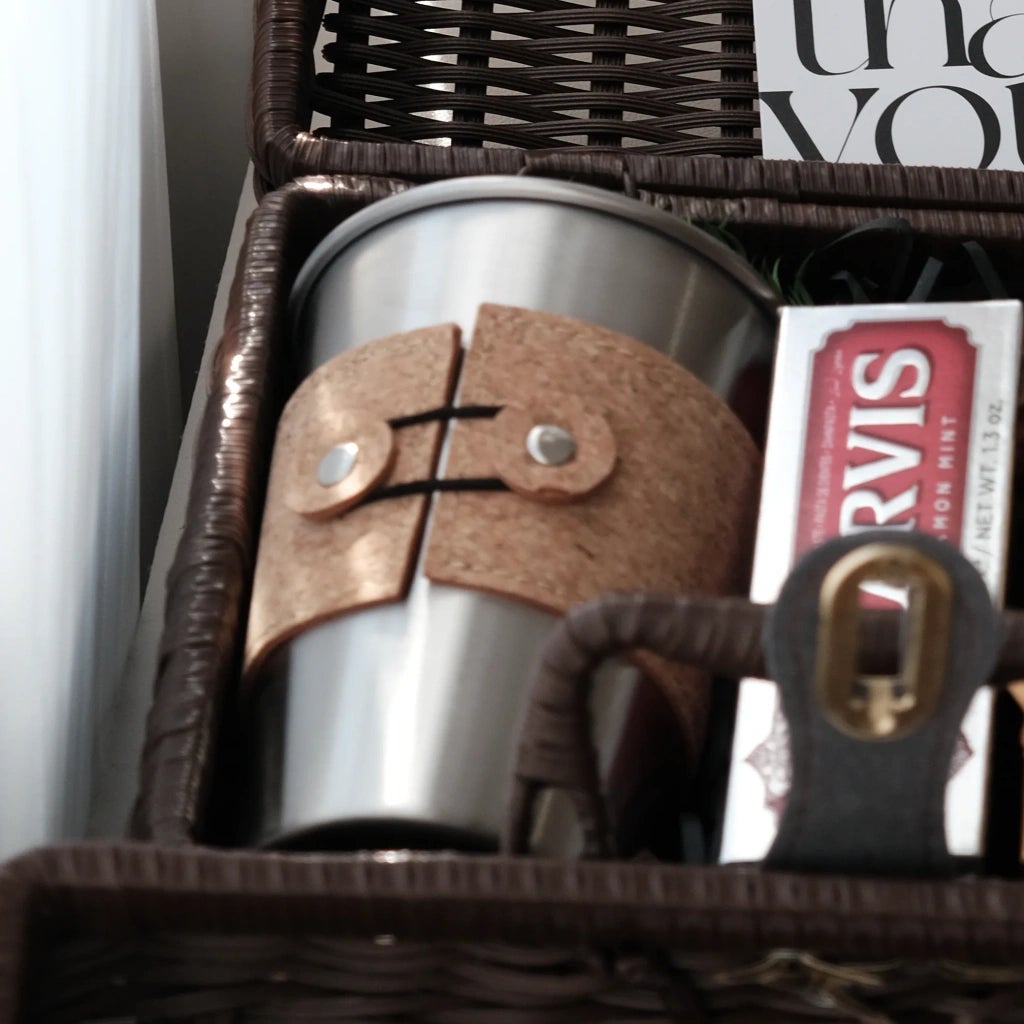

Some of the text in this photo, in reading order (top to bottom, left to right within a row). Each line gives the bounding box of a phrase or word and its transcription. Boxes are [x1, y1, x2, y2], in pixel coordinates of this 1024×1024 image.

[838, 347, 932, 610] RVIS
[933, 415, 957, 543] MON MINT
[975, 502, 994, 541] NET
